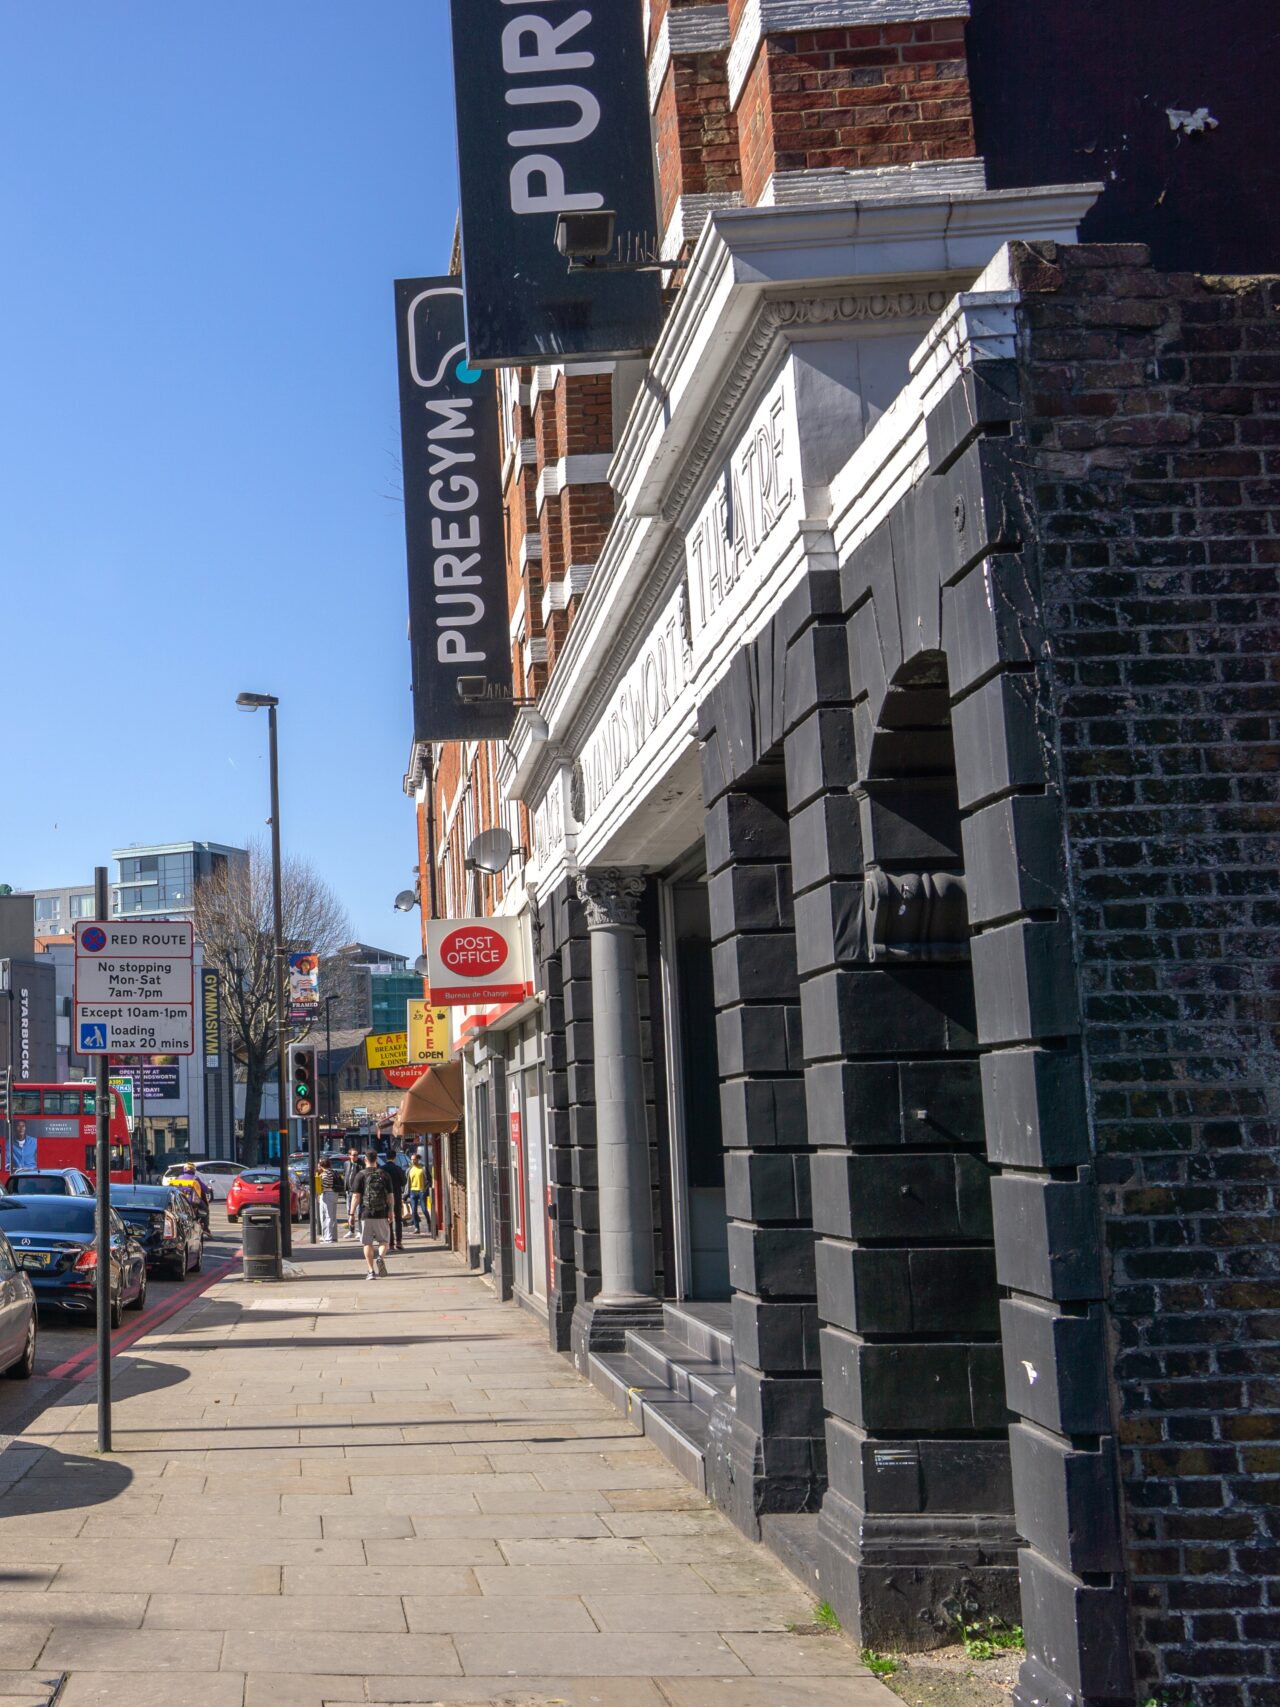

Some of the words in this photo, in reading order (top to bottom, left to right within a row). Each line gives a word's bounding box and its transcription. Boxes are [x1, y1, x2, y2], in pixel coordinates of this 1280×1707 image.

[501, 0, 605, 215] PUR
[425, 397, 487, 664] PUREGYM
[111, 935, 137, 945] RED
[142, 935, 186, 945] ROUTE
[455, 936, 494, 950] POST
[447, 950, 500, 965] OFFICE
[98, 962, 115, 972] No
[119, 962, 172, 974] stopping
[109, 974, 161, 985] Mon-Sat
[108, 988, 163, 999] 7am-7pm
[445, 991, 471, 1000] Bureau
[482, 990, 509, 998] Change
[81, 1007, 123, 1019] Except
[127, 1007, 188, 1019] 10am-1pm
[111, 1025, 155, 1036] loading
[424, 1001, 435, 1050] CAFE
[21, 988, 30, 1079] STARBUCKS
[111, 1039, 135, 1048] max
[140, 1038, 157, 1048] 20
[161, 1038, 189, 1048] mins
[375, 1044, 408, 1052] BREAKFA
[381, 1051, 408, 1059] LUNCHE
[418, 1051, 444, 1060] OPEN
[387, 1058, 408, 1066] DINNE
[389, 1069, 423, 1077] Repairs
